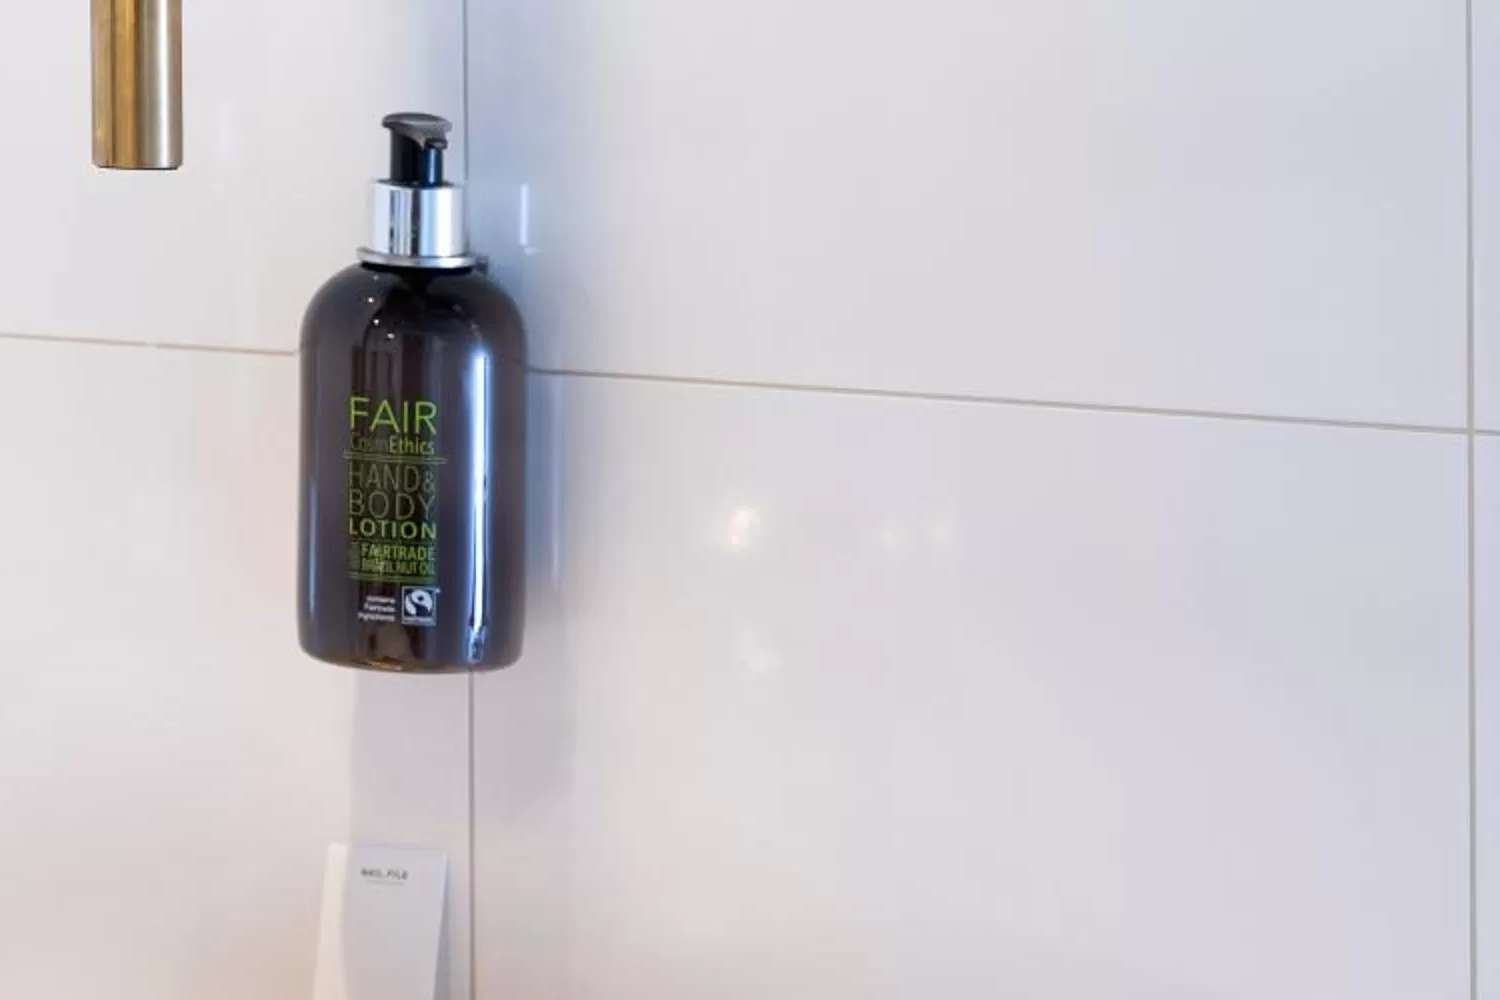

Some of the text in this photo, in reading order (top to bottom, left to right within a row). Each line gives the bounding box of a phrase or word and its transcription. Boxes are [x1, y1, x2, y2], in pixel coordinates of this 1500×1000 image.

[350, 396, 437, 434] FAIR
[349, 490, 436, 520] BODY
[349, 520, 437, 540] LOTION
[360, 544, 436, 562] FAIRTRADE
